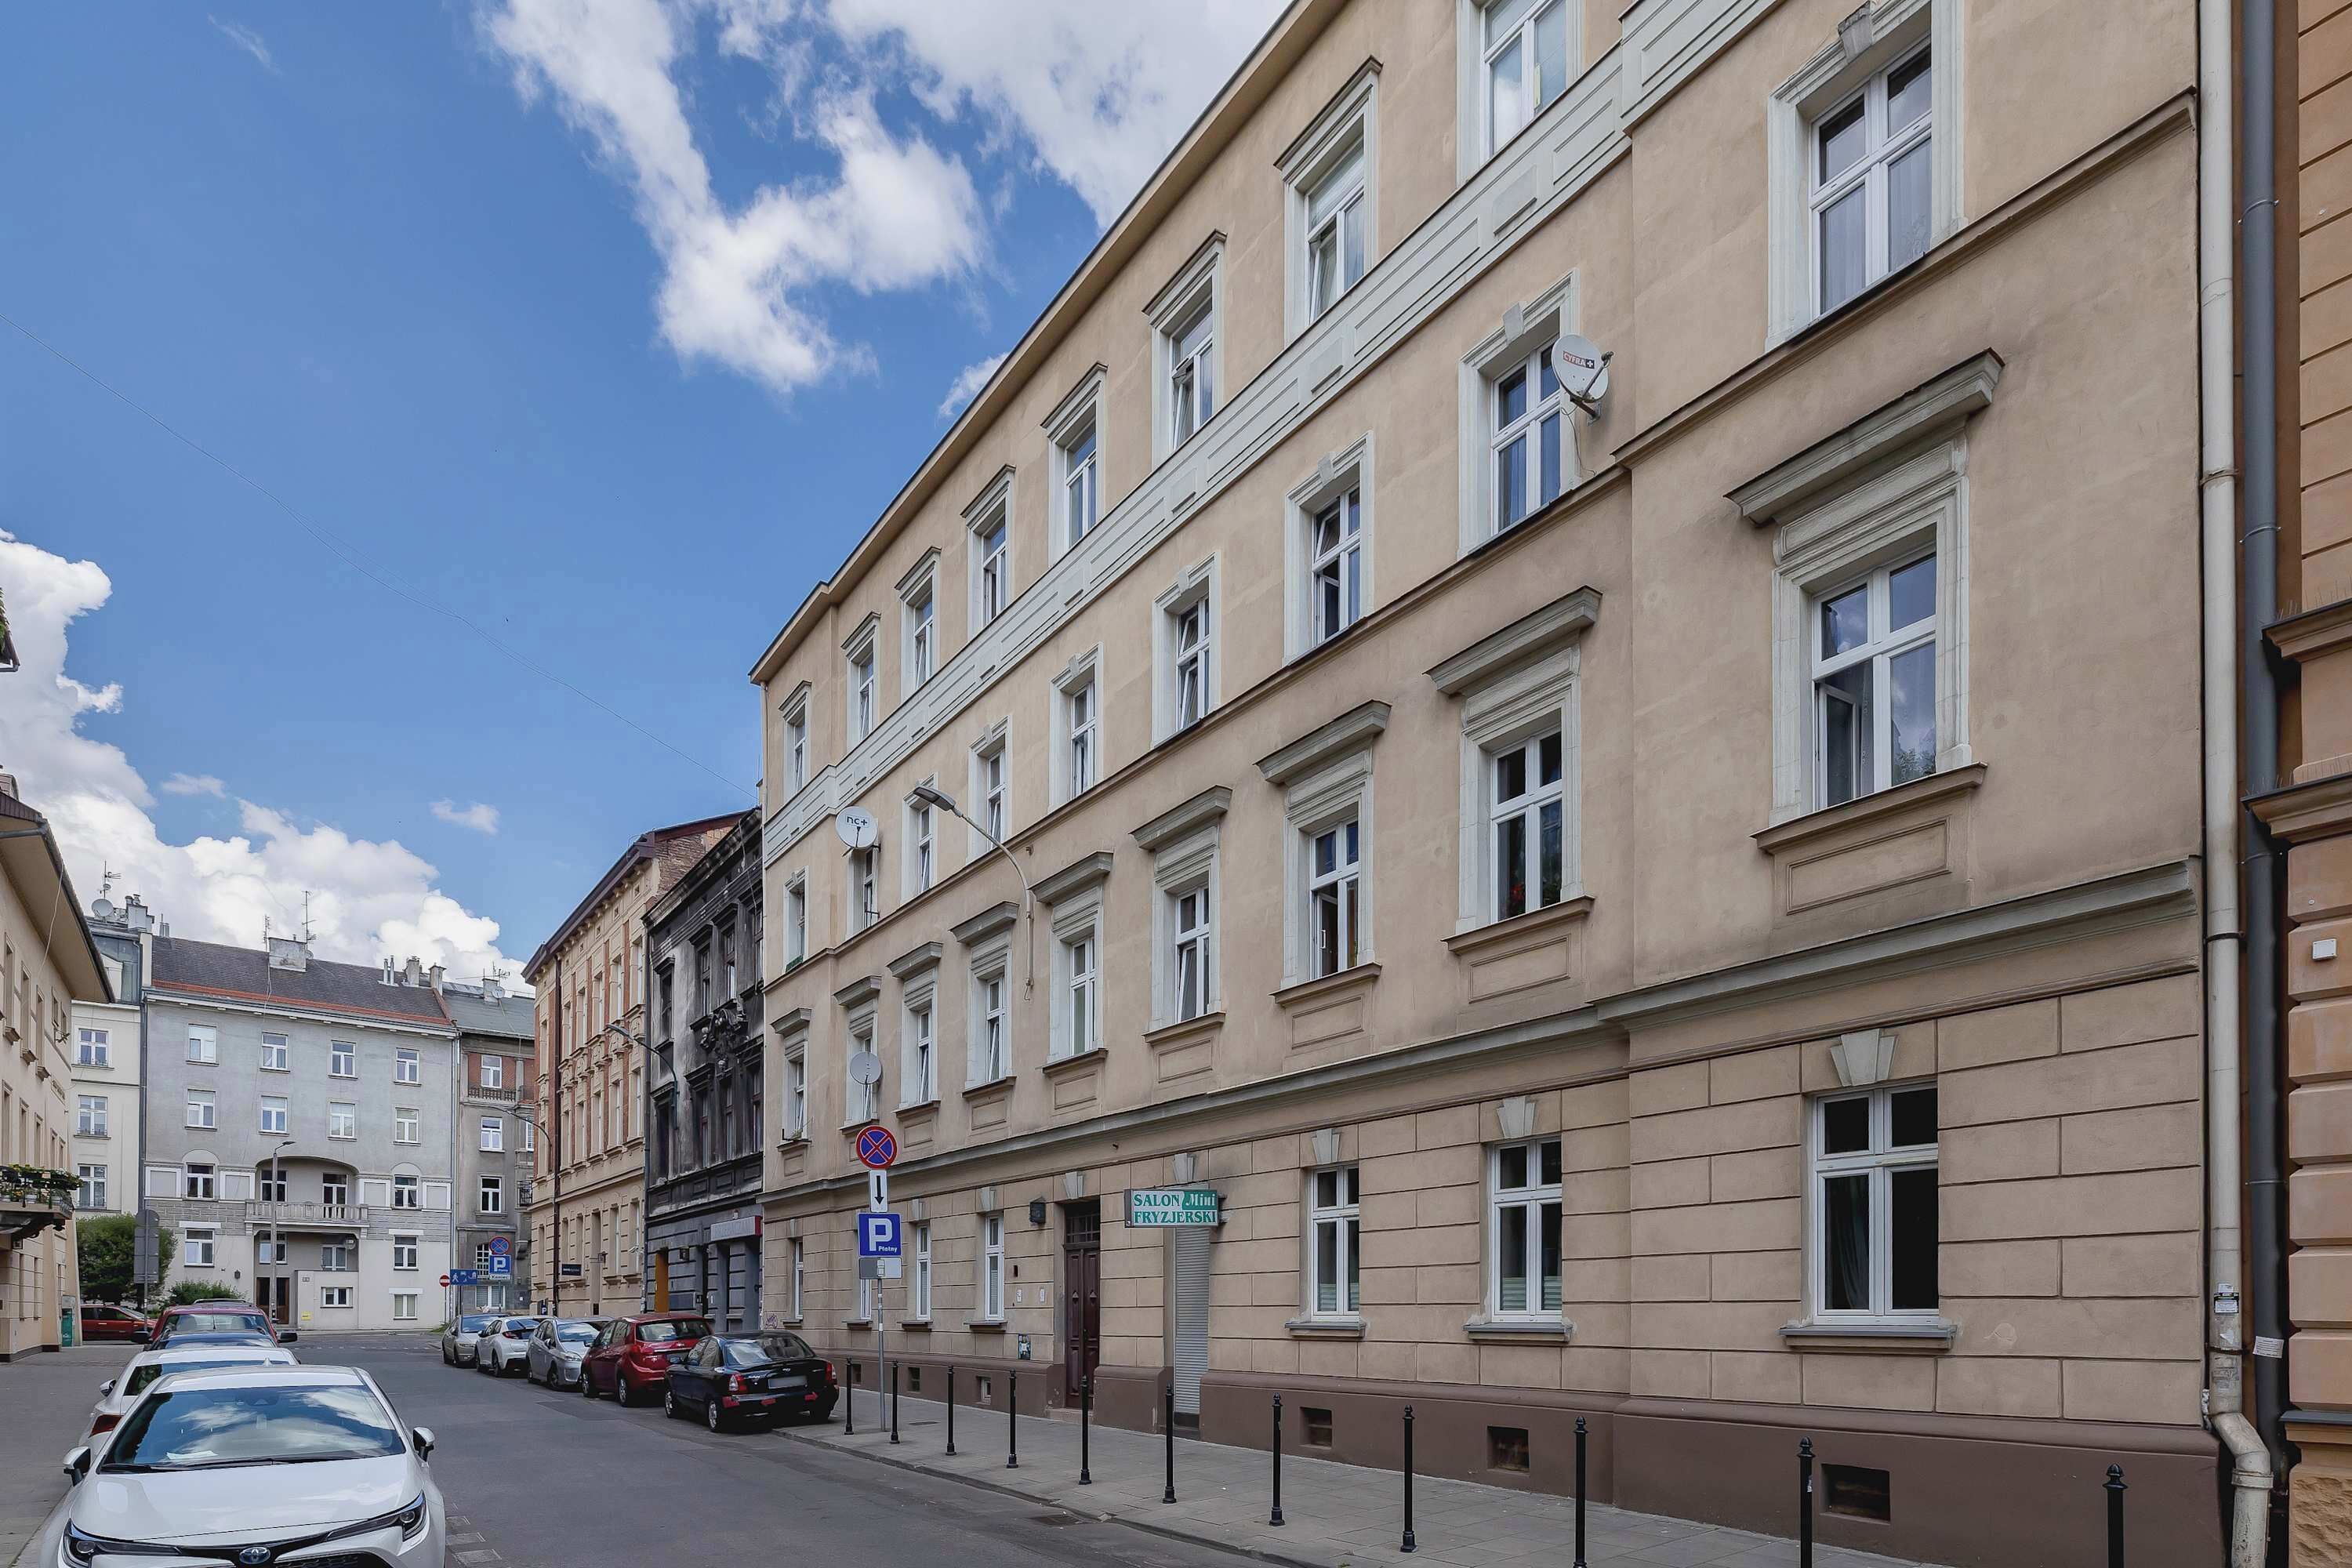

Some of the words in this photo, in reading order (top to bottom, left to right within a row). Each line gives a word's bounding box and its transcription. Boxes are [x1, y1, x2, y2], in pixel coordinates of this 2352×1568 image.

[847, 816, 868, 826] nc+
[1134, 1194, 1180, 1207] SALON
[1185, 1193, 1216, 1207] Mini
[1134, 1210, 1216, 1223] FRYZJERSKI
[868, 1218, 893, 1251] P
[494, 1257, 506, 1272] P
